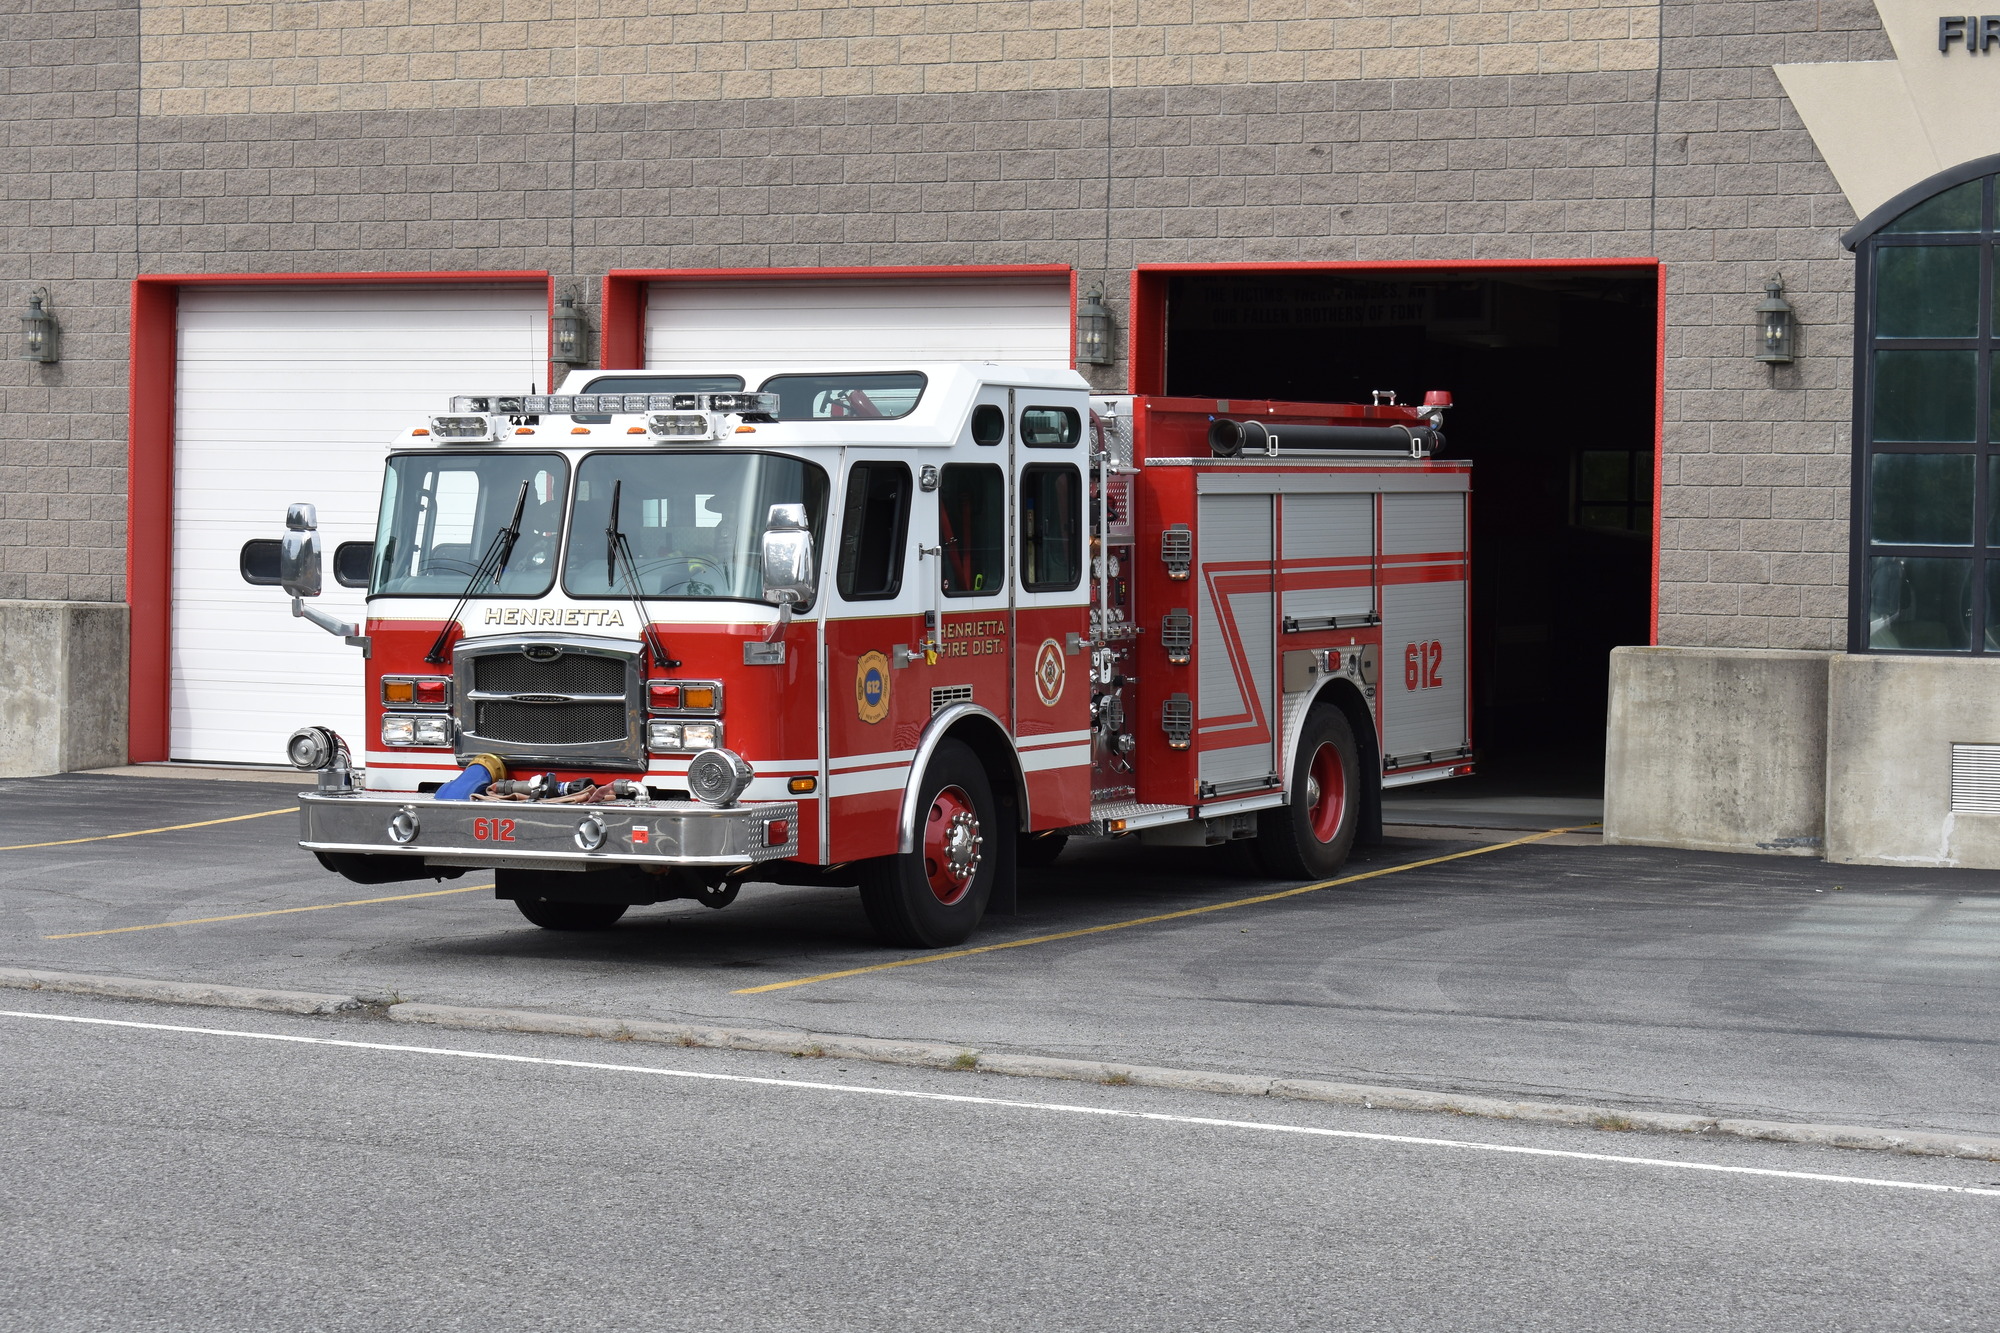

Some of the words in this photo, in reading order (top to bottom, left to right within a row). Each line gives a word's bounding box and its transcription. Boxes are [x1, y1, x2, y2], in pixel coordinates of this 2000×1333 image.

[1243, 307, 1289, 323] FALLEN
[1295, 305, 1363, 323] BROTHERS
[1368, 304, 1384, 320] OF
[1390, 303, 1424, 320] FDNY
[484, 607, 624, 626] HENRIETTA
[941, 641, 968, 657] FIRE
[972, 639, 1003, 655] DIST.
[1405, 639, 1442, 692] 612
[866, 680, 880, 694] 612
[473, 817, 516, 842] 612
